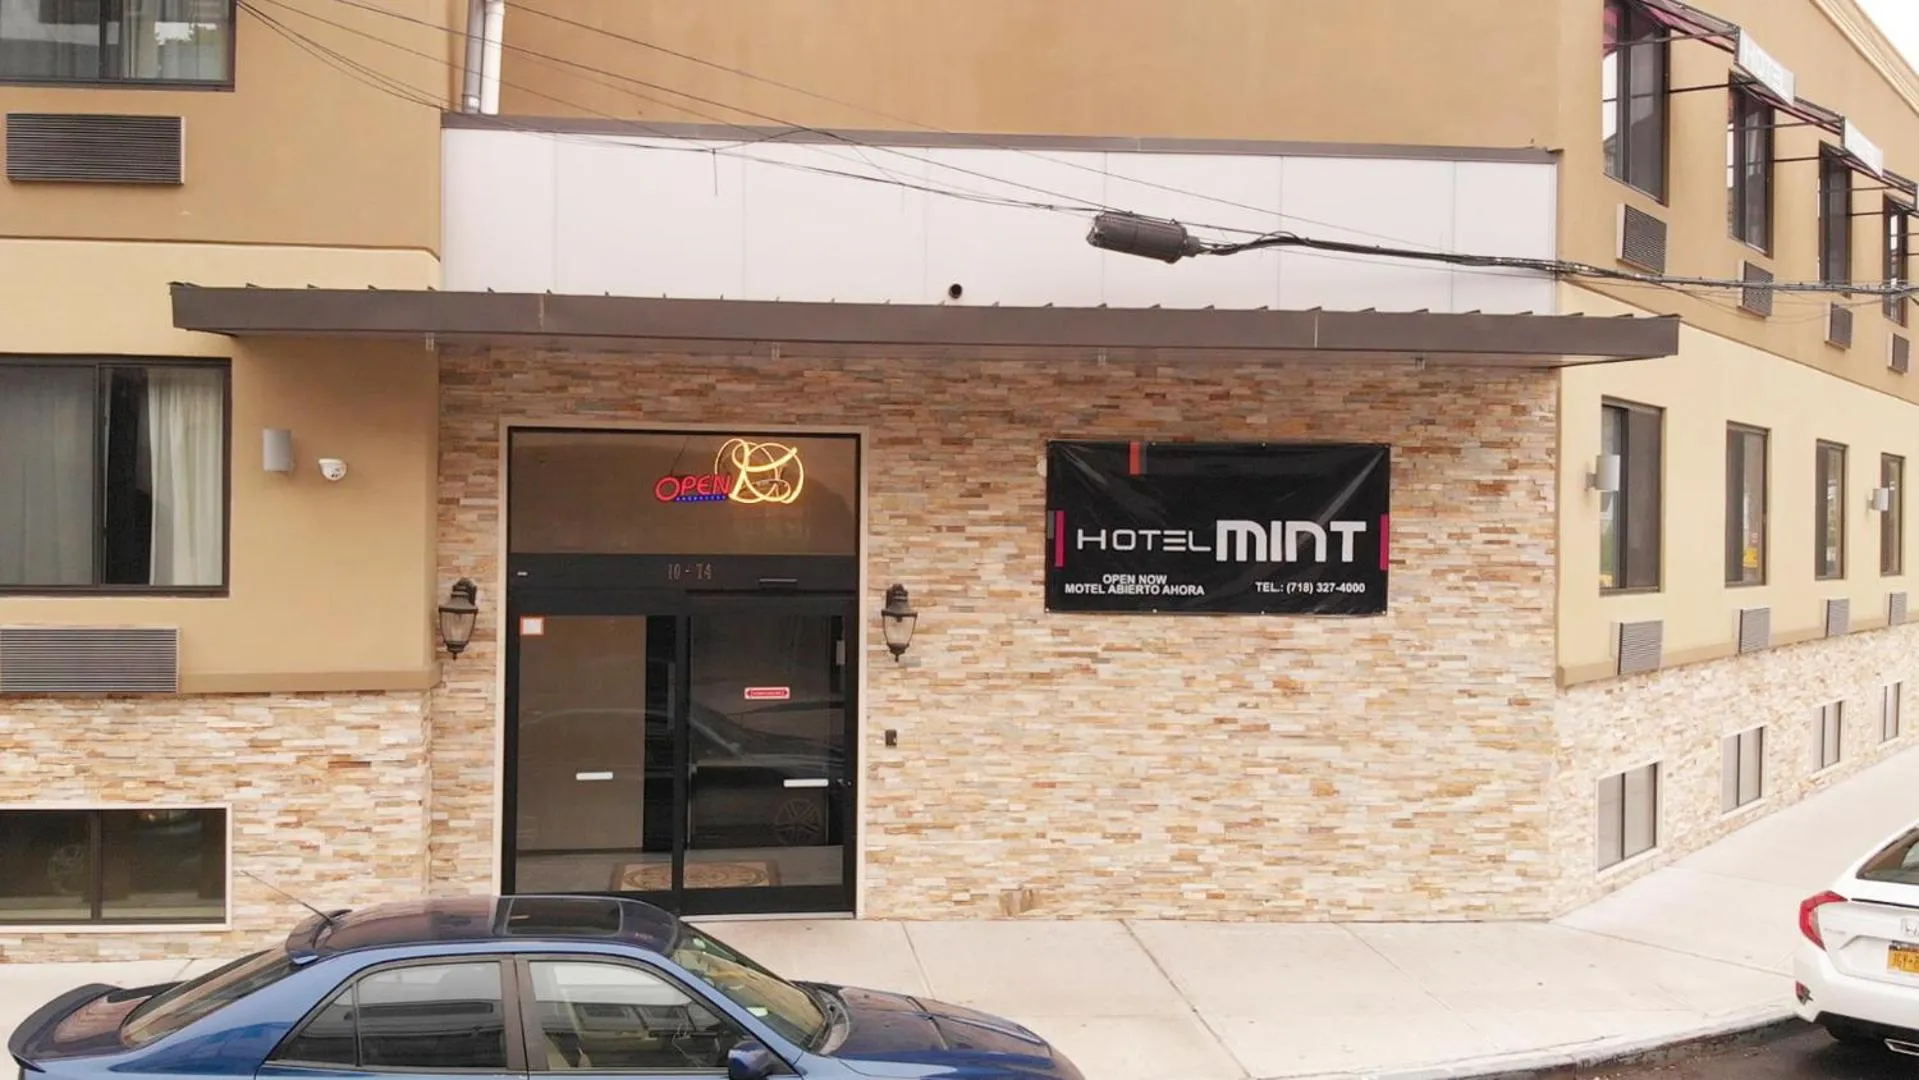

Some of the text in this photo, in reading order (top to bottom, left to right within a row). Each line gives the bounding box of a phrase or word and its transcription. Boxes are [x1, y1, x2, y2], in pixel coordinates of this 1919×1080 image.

[655, 475, 732, 501] OPEN
[1076, 519, 1367, 562] HOTEL MINT
[1102, 574, 1168, 585] OPEN NOW
[1064, 583, 1205, 596] MOTEL ABIERTO AHORA
[1255, 581, 1366, 595] TEL.: (718) 327-4000
